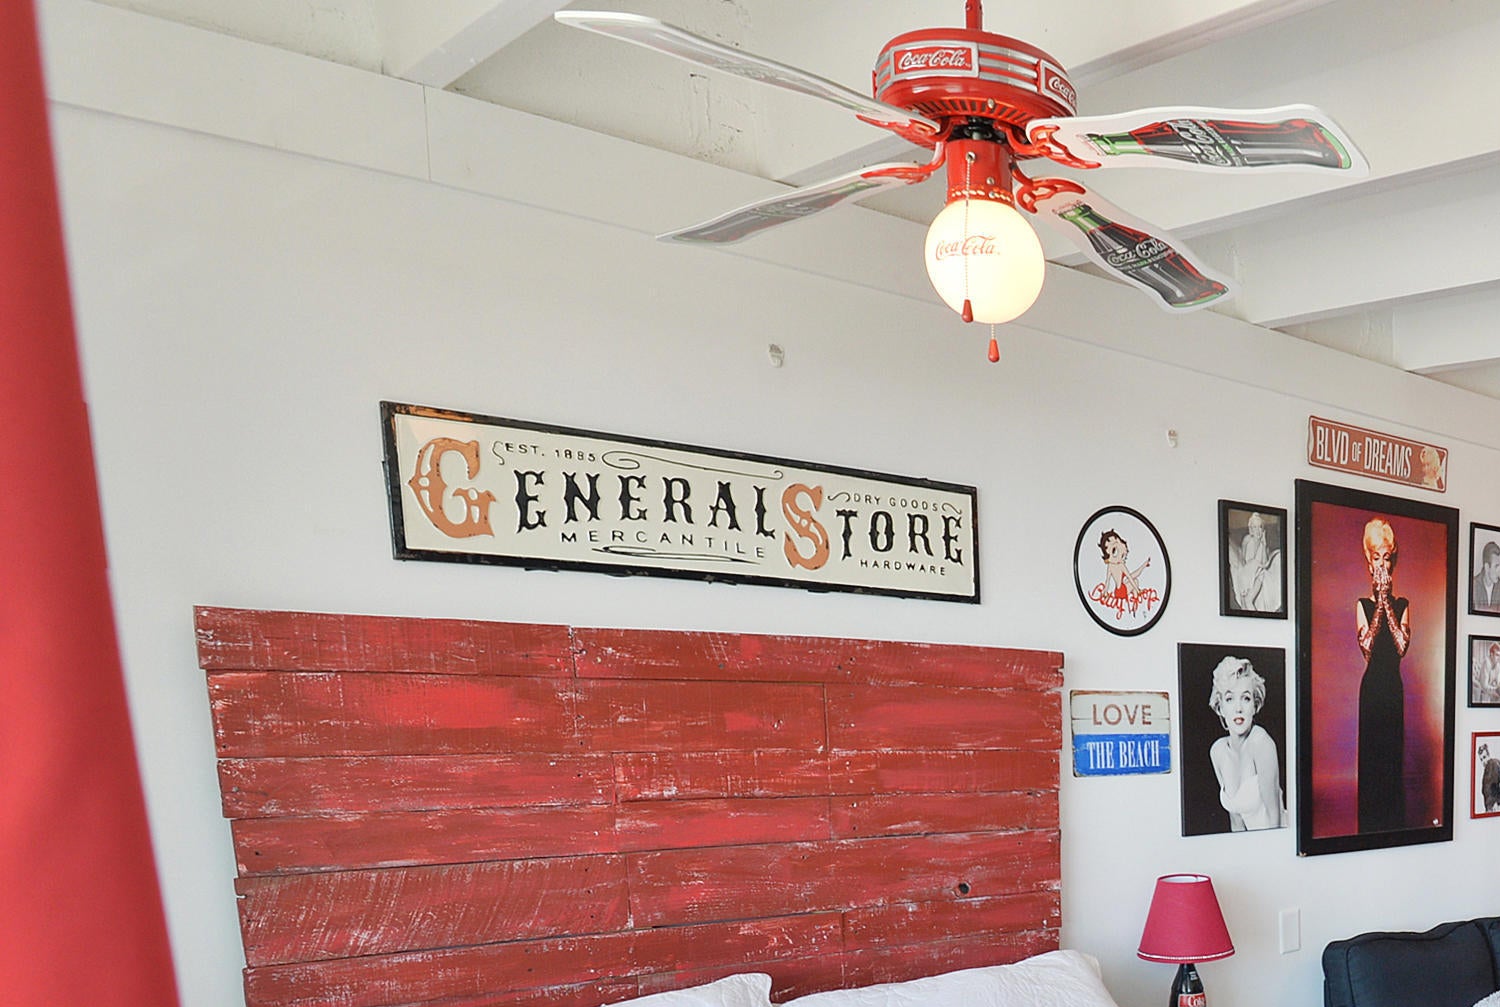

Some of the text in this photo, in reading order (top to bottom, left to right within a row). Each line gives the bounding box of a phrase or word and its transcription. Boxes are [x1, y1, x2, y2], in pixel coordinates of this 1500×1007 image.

[898, 48, 967, 70] Coca-Cola
[935, 235, 998, 260] Coca-Cola
[505, 441, 545, 458] EST.
[1316, 425, 1350, 465] BLVD
[1364, 433, 1412, 479] DREAMS
[408, 436, 964, 571] GENERAL STORE
[853, 493, 938, 512] DRY GOODS
[561, 529, 766, 559] MERCANTILE
[859, 558, 946, 576] HARDWARE
[1092, 704, 1152, 727] LOVE
[1086, 741, 1160, 770] THE BEACH
